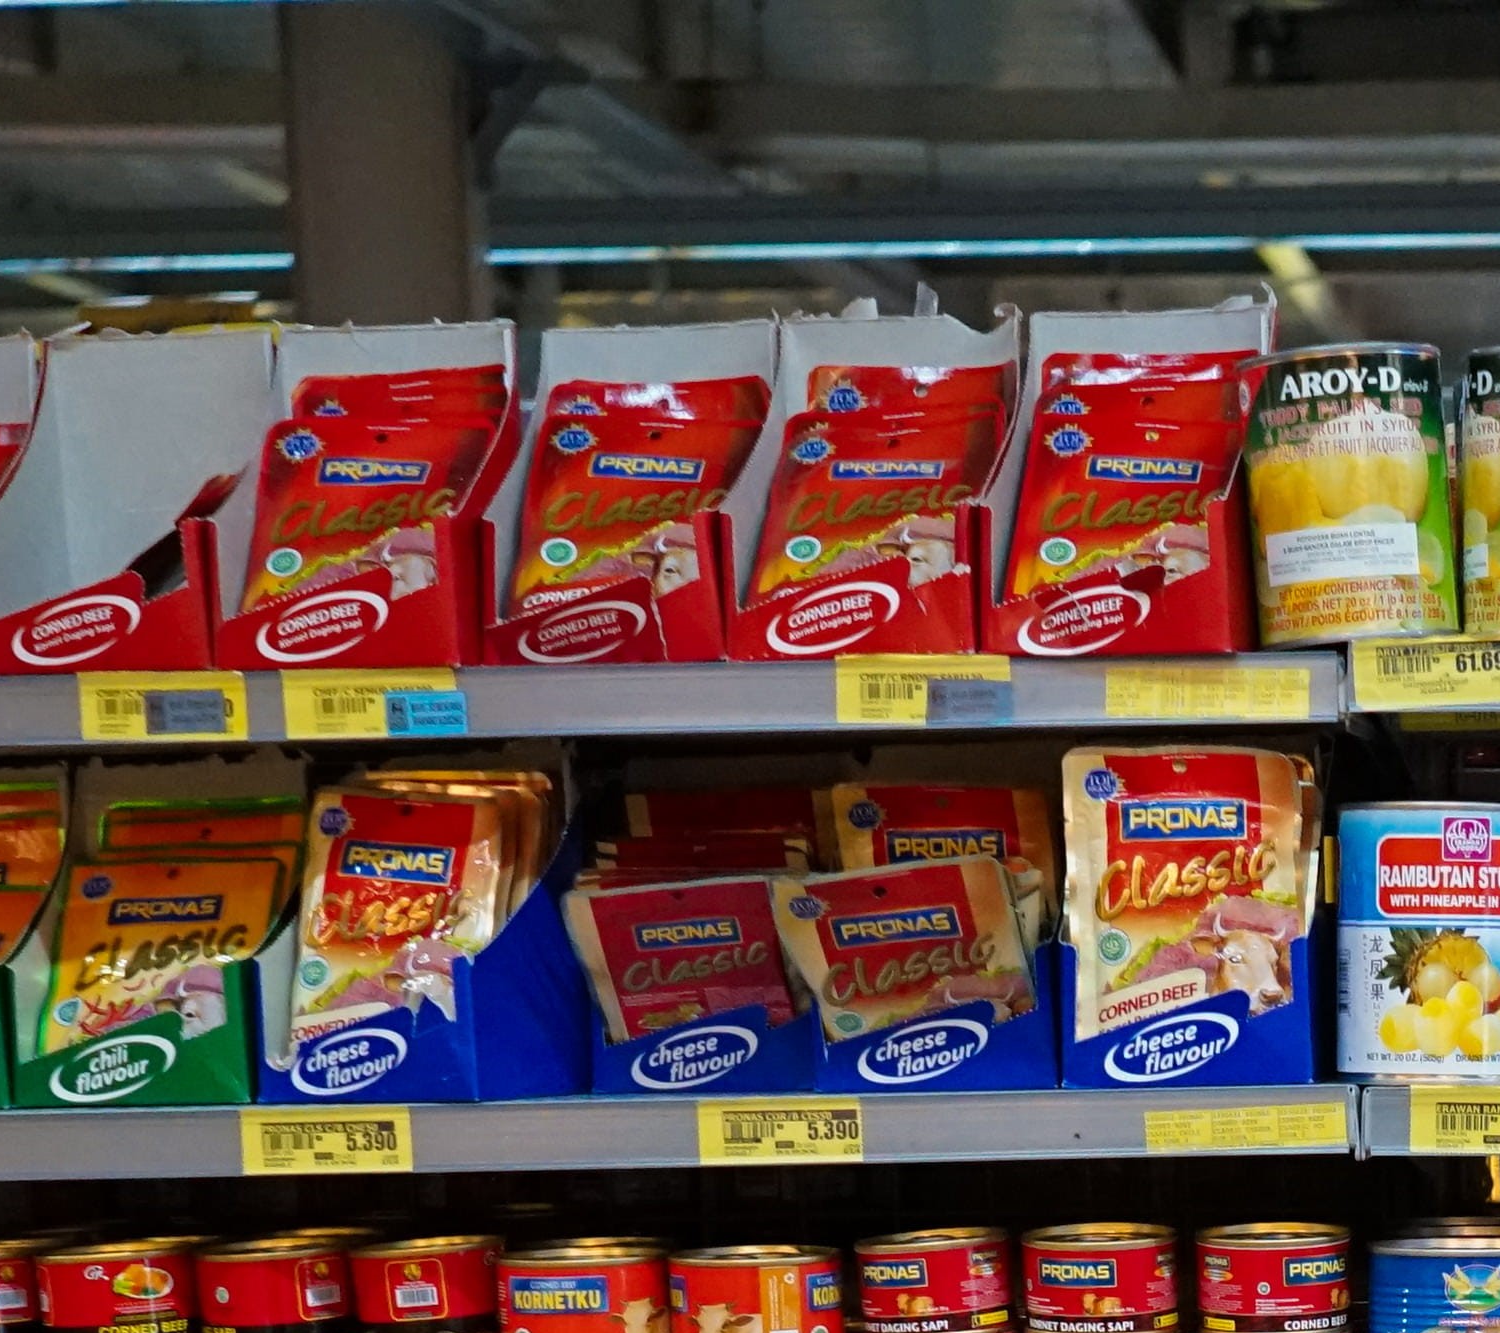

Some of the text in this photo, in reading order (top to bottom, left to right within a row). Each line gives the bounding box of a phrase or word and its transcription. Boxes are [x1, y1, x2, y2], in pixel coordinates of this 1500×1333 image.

[1130, 805, 1238, 833] PRONAS
[1098, 841, 1278, 919] Classic
[1124, 1025, 1197, 1056] cheese
[1144, 1038, 1223, 1072] flavour
[807, 1120, 859, 1141] 5.390
[1041, 1262, 1112, 1283] PRONAS
